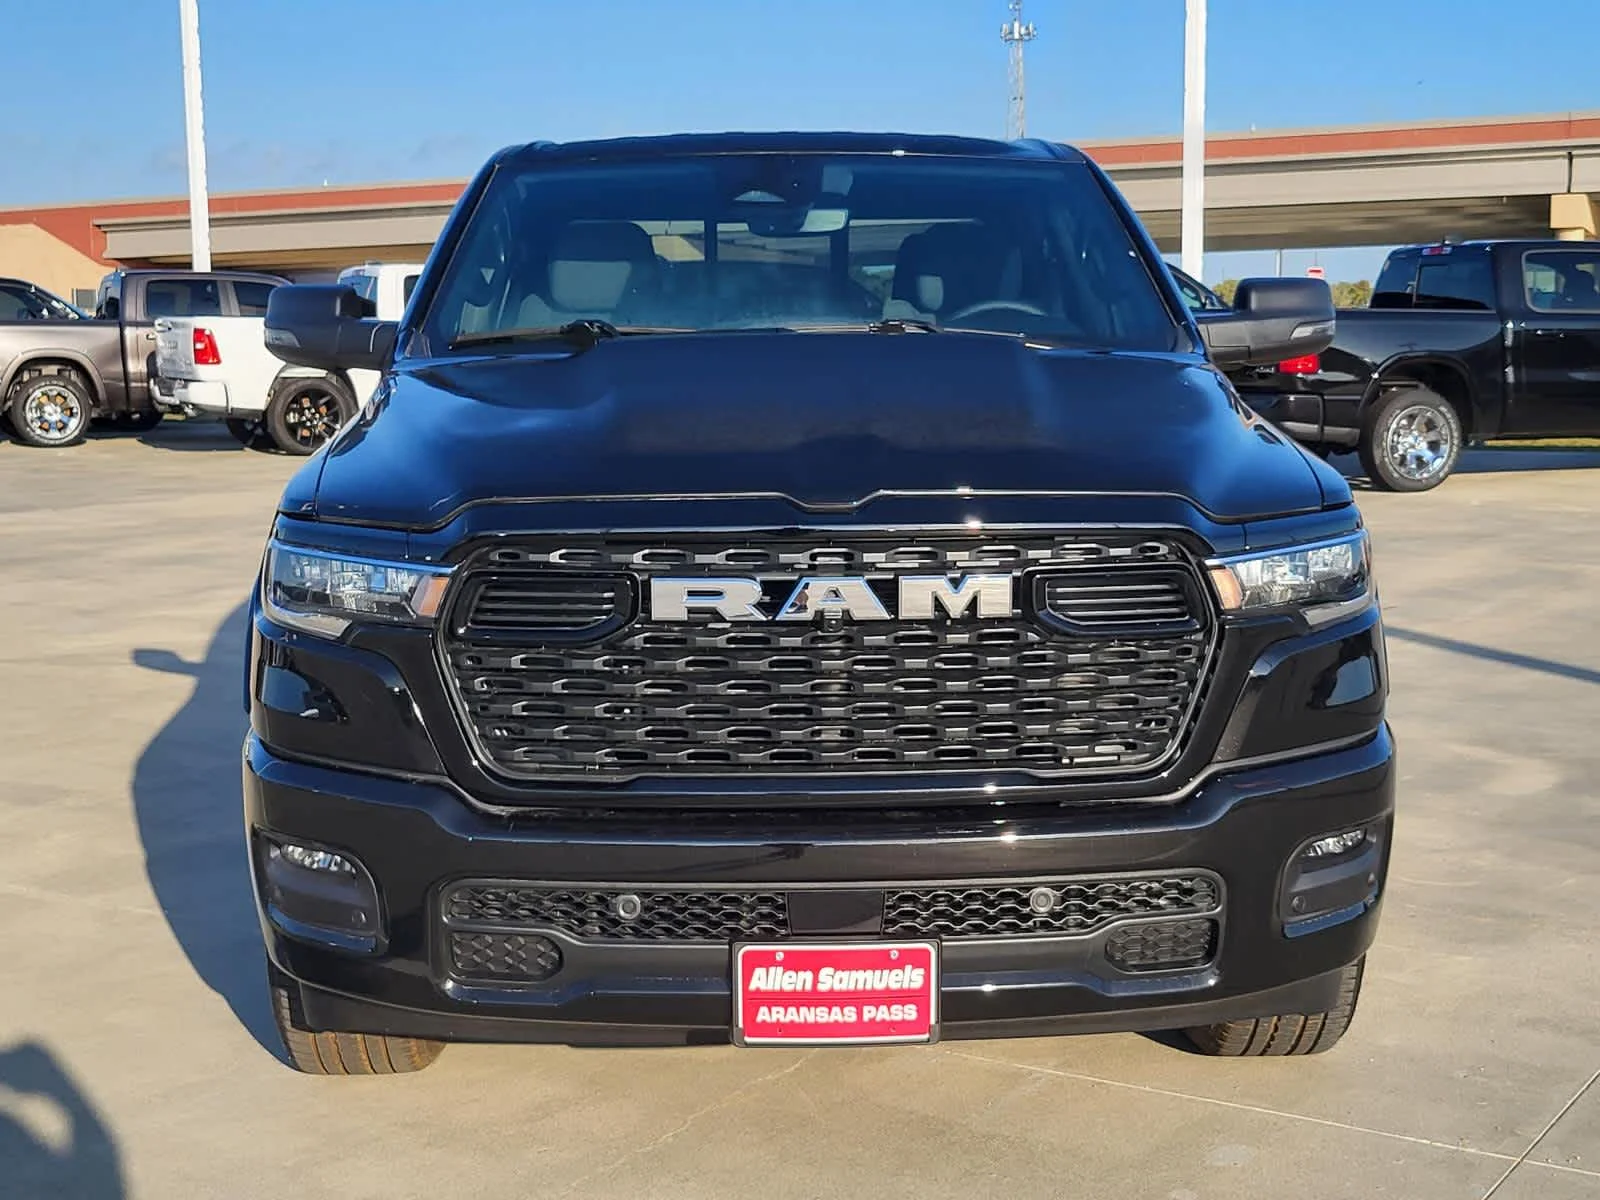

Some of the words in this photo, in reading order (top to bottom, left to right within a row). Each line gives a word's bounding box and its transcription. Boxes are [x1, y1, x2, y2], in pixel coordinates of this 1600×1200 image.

[650, 575, 1013, 621] RAM
[748, 966, 814, 992] Allen
[816, 965, 925, 992] Samuels
[755, 1005, 858, 1024] ARANSAS
[862, 1004, 918, 1022] PASS
